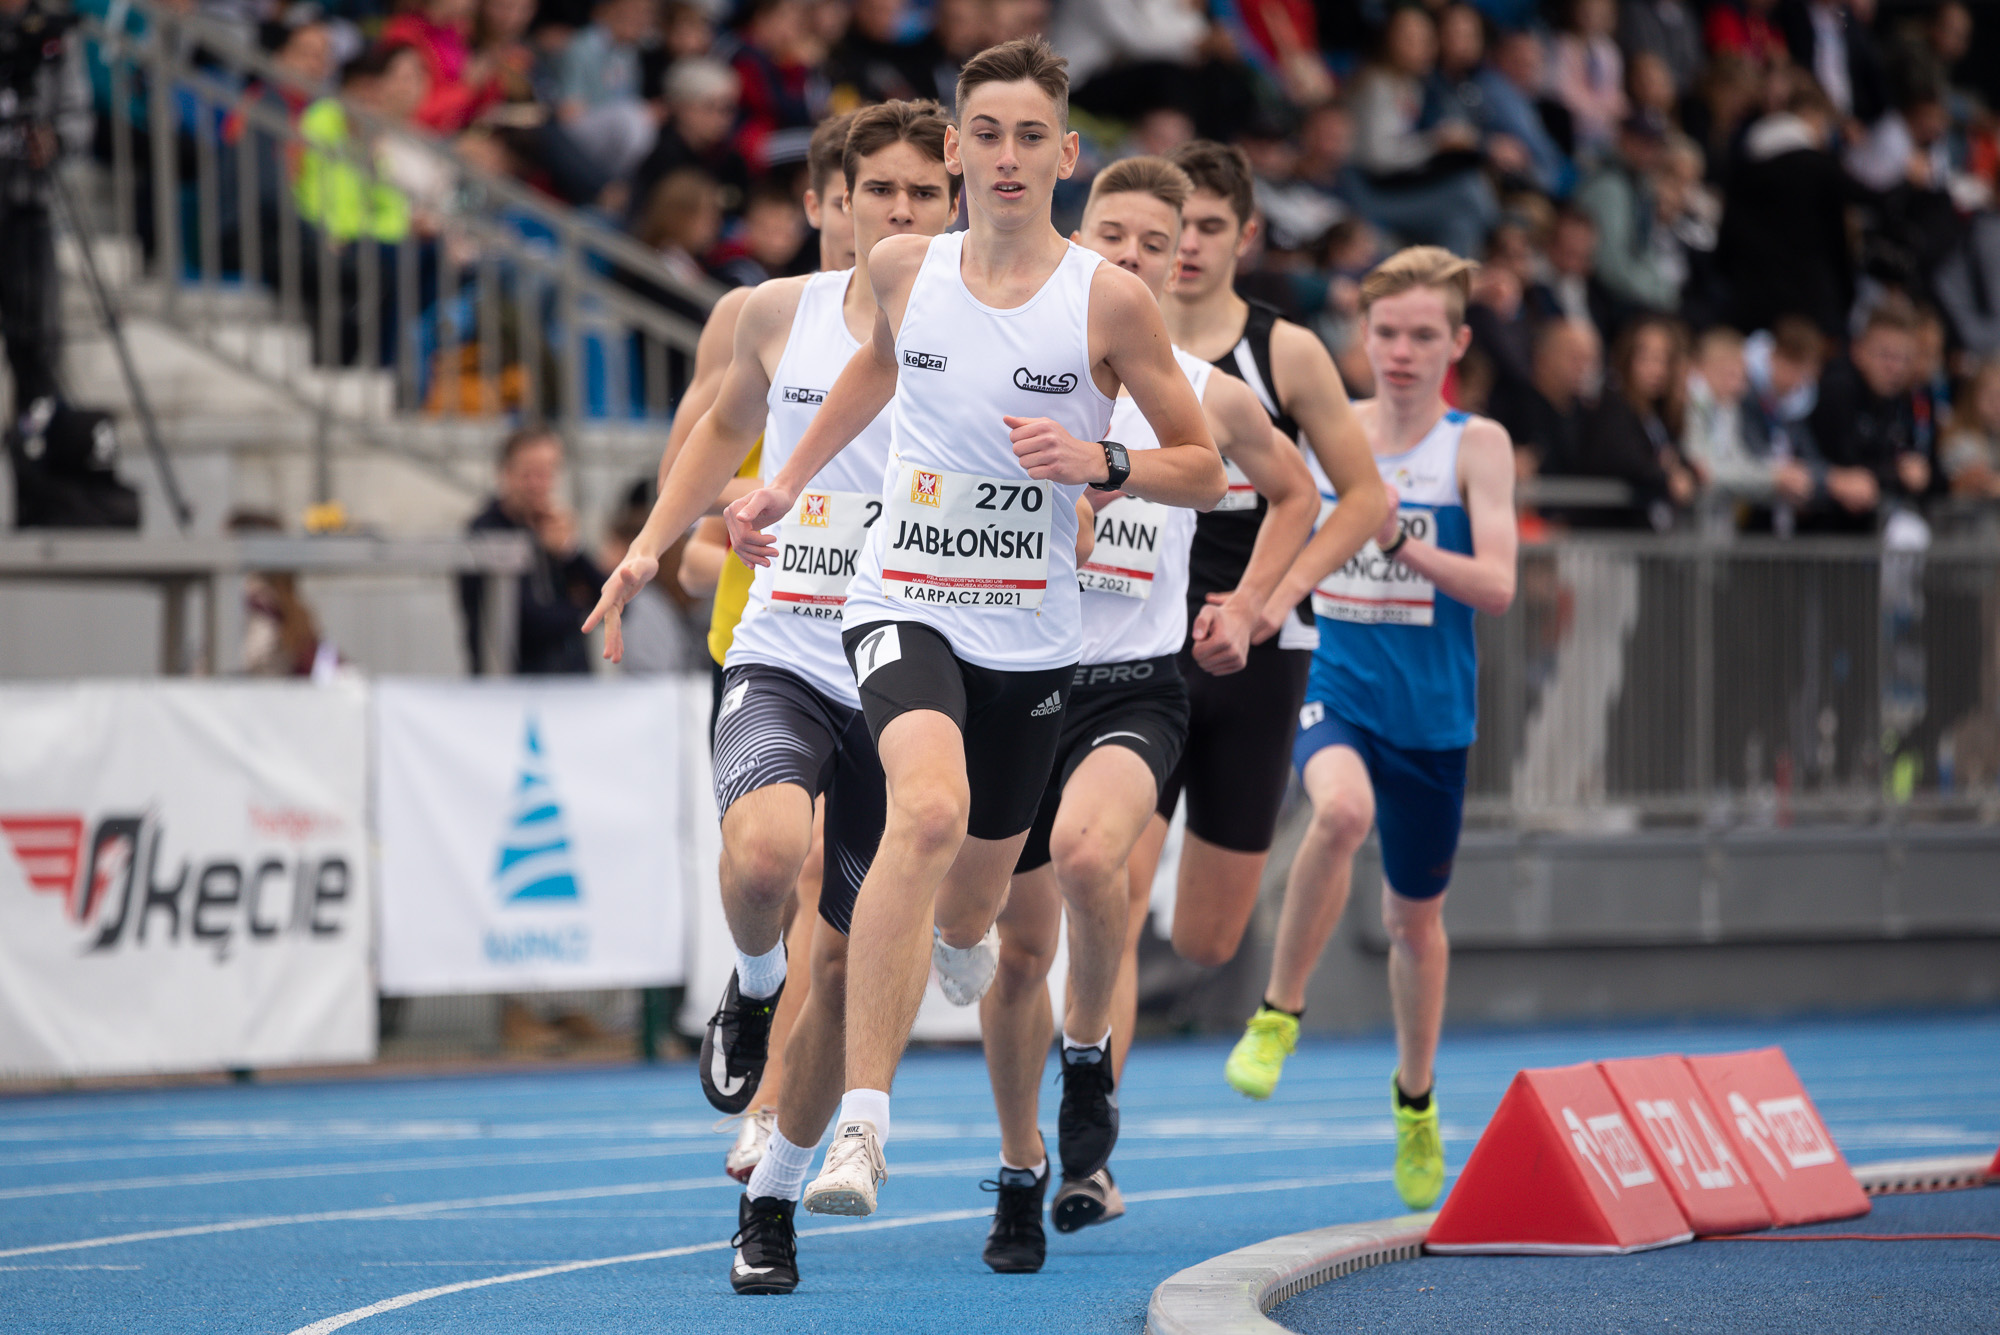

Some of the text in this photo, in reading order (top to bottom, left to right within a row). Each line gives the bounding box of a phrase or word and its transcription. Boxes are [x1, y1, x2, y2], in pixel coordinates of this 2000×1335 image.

[912, 492, 938, 506] PZLA
[975, 482, 1043, 512] 270
[893, 520, 1043, 560] JABŁOŃSKI
[1098, 577, 1131, 593] 2021
[904, 586, 1021, 606] KARPACZ 2021
[861, 630, 885, 671] 7
[1030, 703, 1063, 717] adidas
[845, 1125, 861, 1133] NIKE
